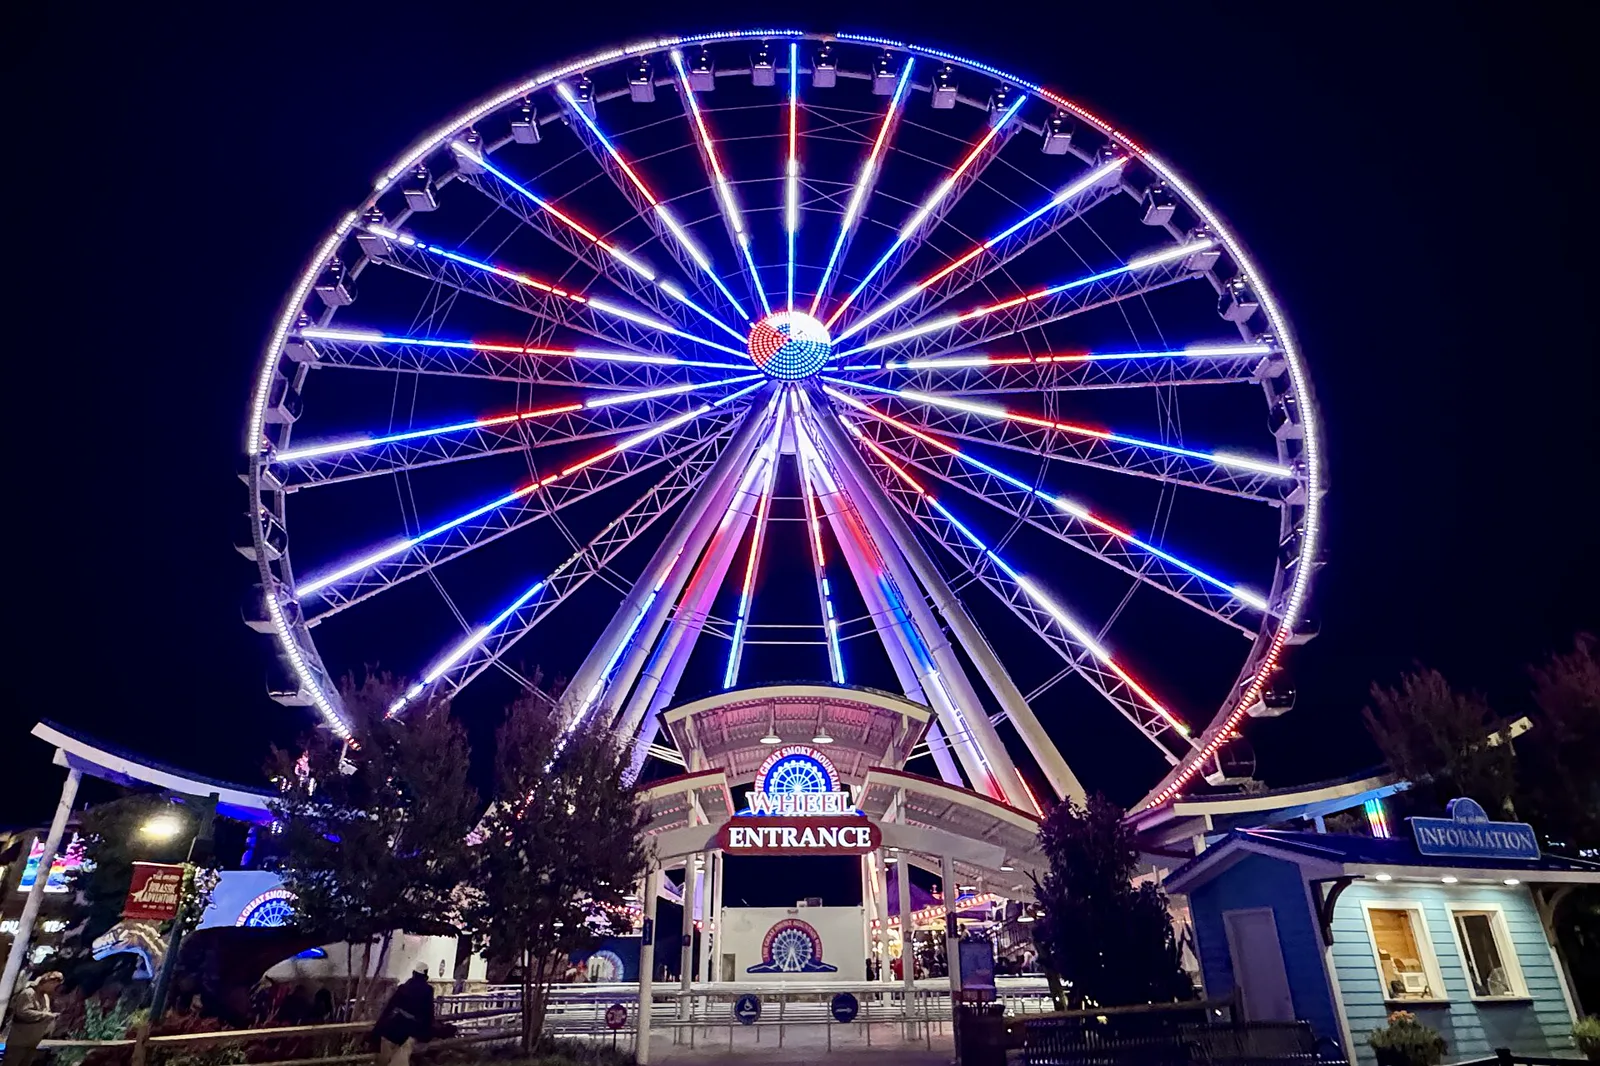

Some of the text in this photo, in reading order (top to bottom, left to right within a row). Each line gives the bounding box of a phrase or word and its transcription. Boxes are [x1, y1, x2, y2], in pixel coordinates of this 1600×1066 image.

[755, 745, 841, 792] THE GREAT SMOKY MOUNTAIN
[745, 791, 856, 815] WHEEL
[728, 827, 872, 848] ENTRANCE
[1418, 827, 1534, 850] INFORMATION
